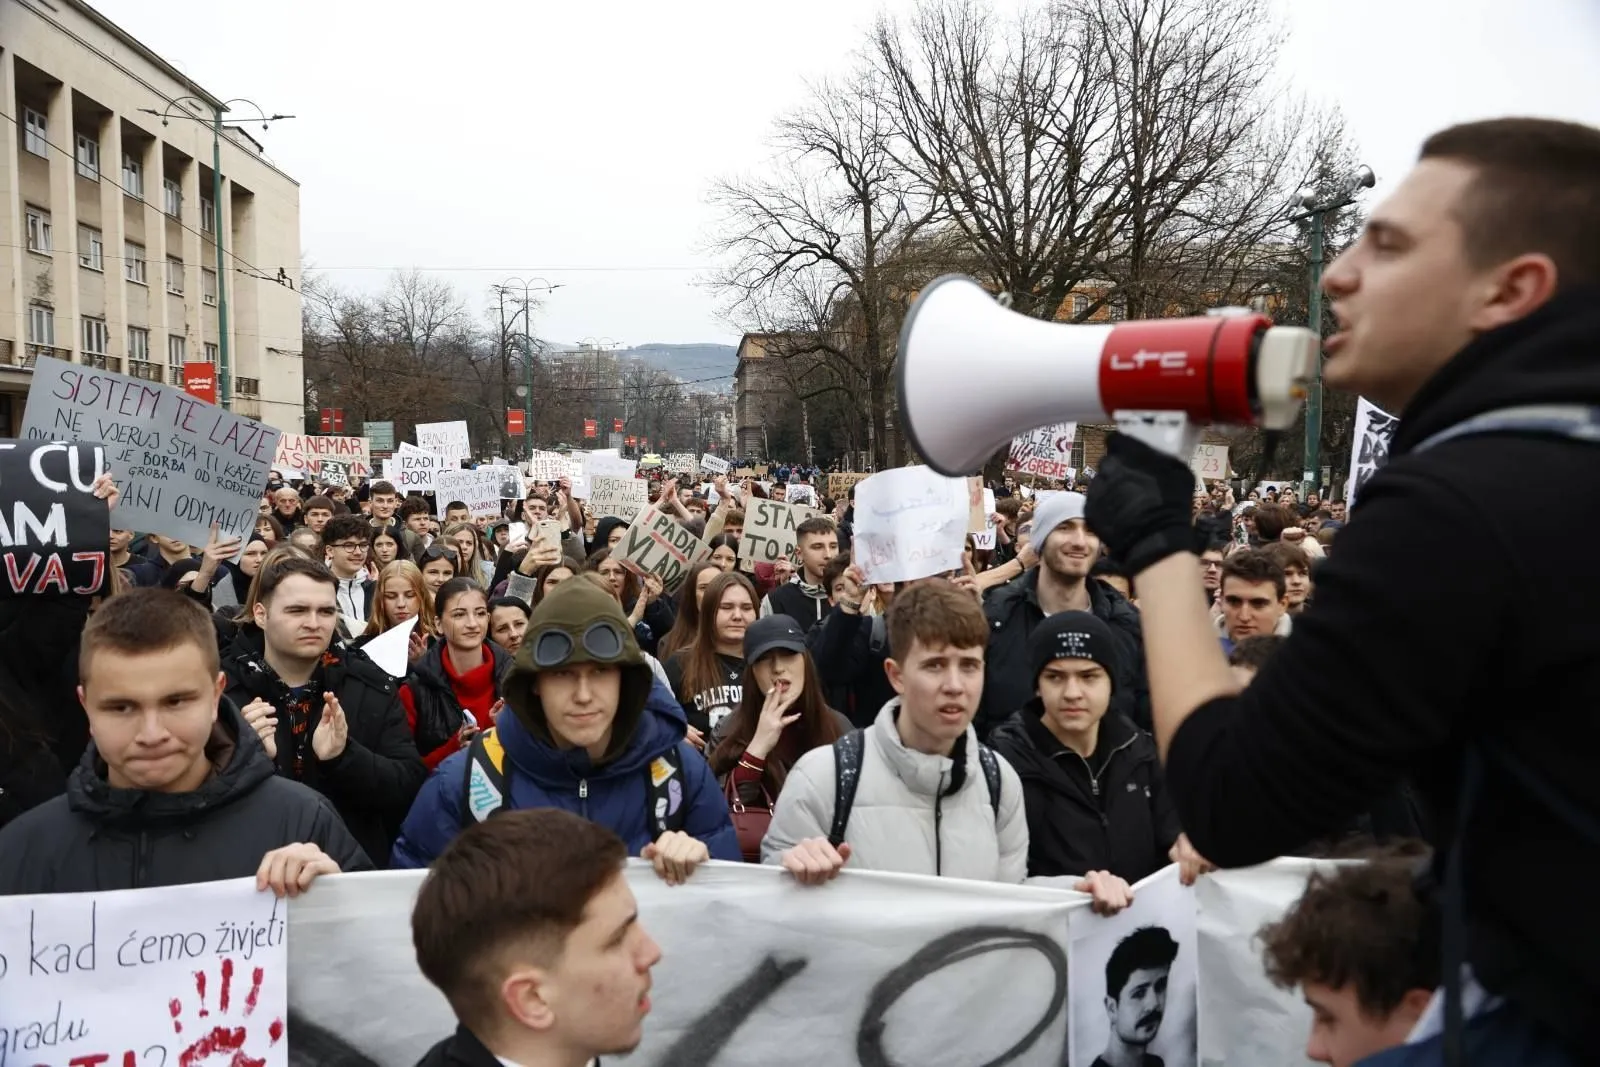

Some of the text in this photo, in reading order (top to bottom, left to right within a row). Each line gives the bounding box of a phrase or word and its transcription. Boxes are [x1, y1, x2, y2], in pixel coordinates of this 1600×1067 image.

[52, 370, 275, 464] SISTEM TE LAŽE
[55, 407, 84, 432] NE
[98, 418, 160, 450] VJERUJ
[167, 433, 197, 461] ŠTA
[203, 450, 218, 472] TI
[224, 461, 262, 486] KAŽE
[305, 436, 363, 455] NEMAR
[115, 449, 134, 462] JE
[143, 452, 186, 474] BORBA
[194, 468, 210, 483] OD
[128, 466, 168, 481] GROBA
[402, 470, 432, 485] BORI
[1201, 458, 1219, 472] 23
[591, 490, 613, 501] NAM
[754, 500, 797, 532] ŠTA
[652, 515, 697, 561] PADA
[626, 524, 689, 593] VLADA
[29, 897, 285, 976] kad ćemo živjeti
